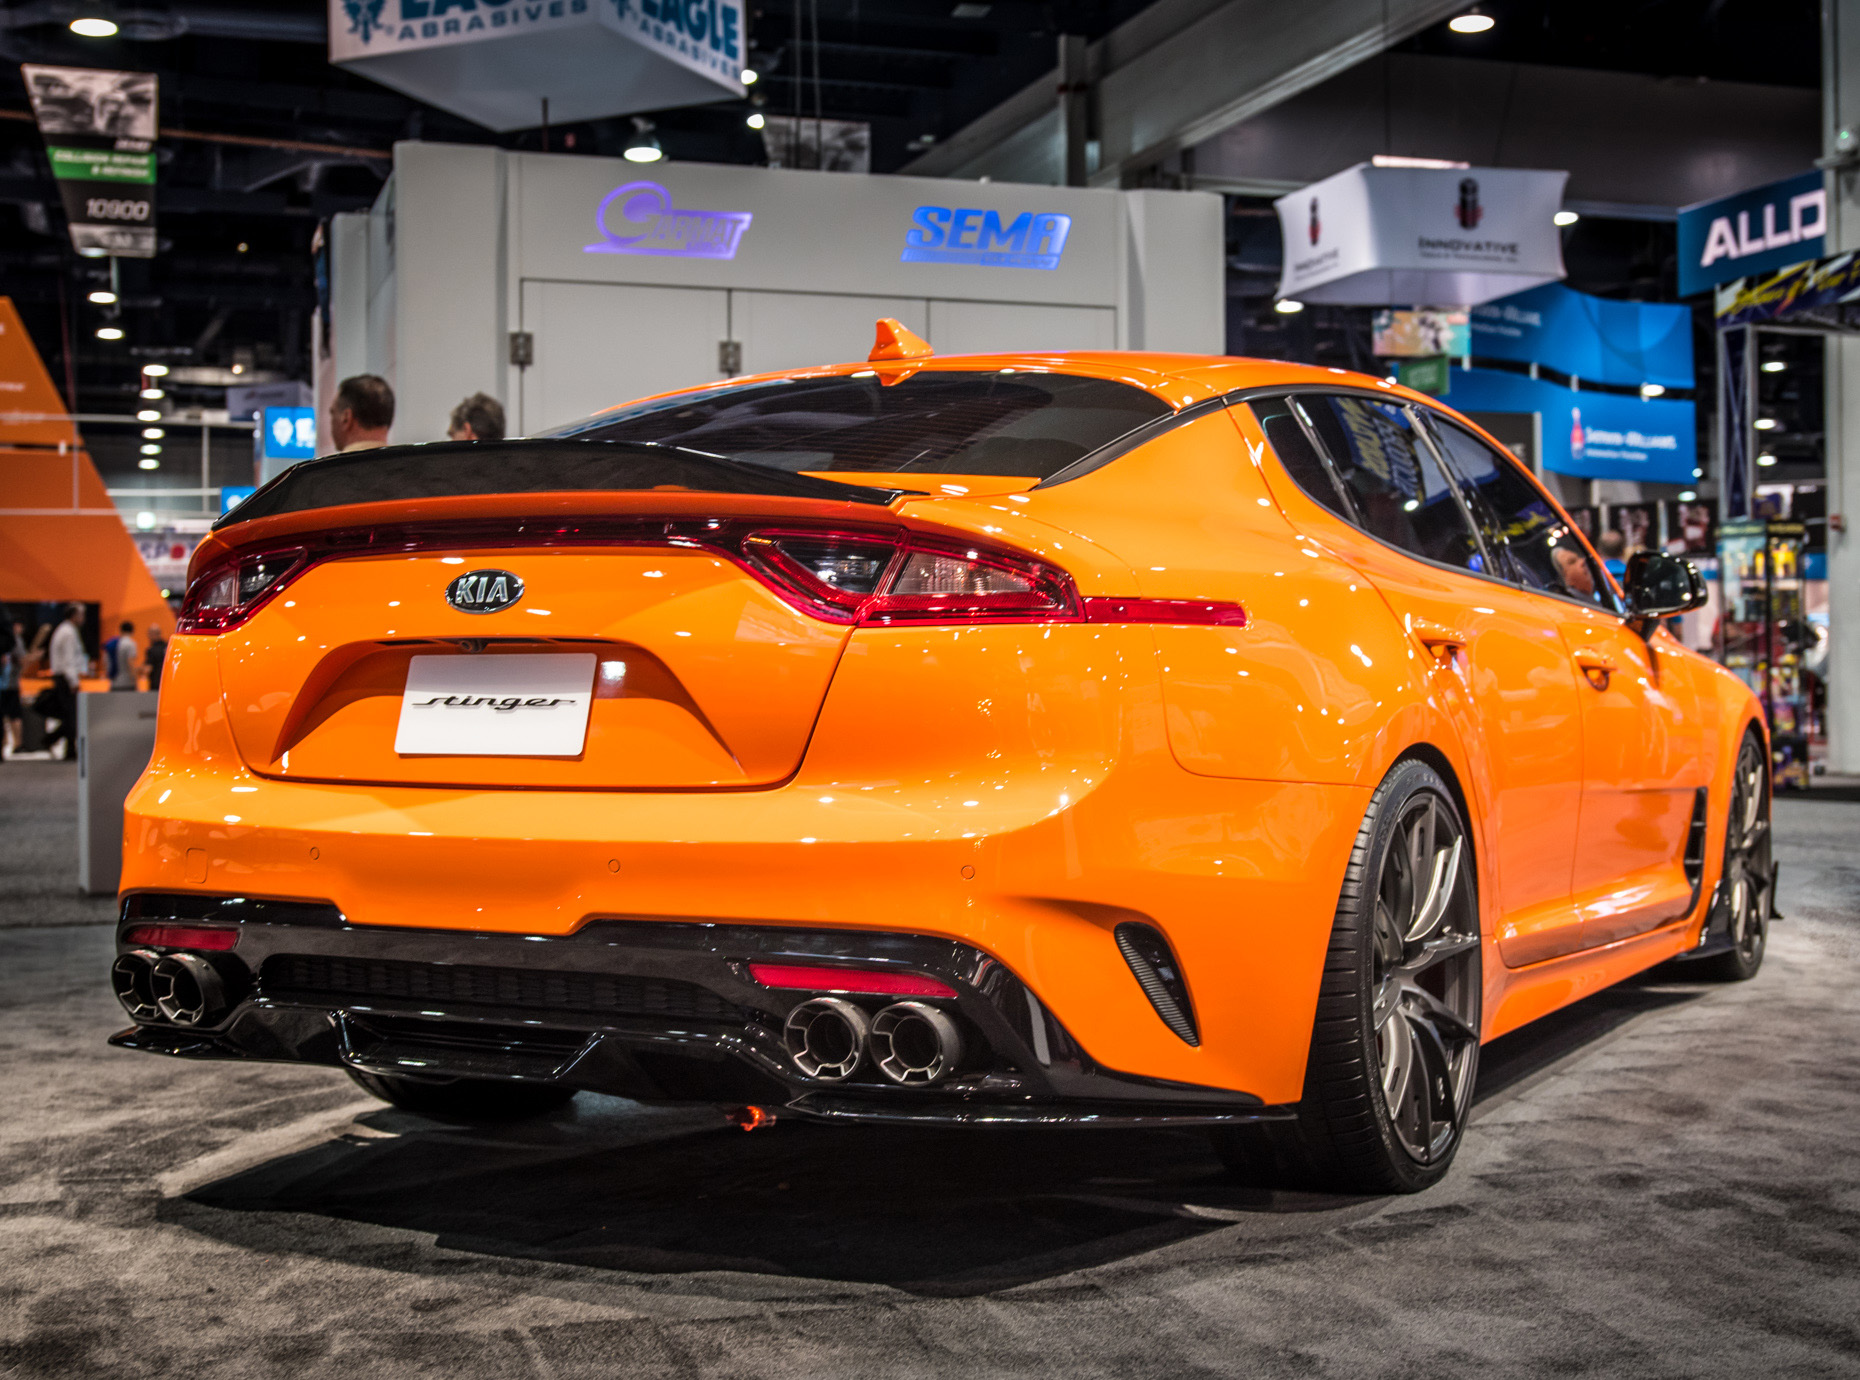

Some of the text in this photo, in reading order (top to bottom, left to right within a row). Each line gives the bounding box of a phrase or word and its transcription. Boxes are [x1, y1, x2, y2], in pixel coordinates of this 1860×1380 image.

[398, 1, 588, 41] ABRASIVES
[905, 206, 1073, 255] SEMA
[1417, 236, 1519, 255] INNOVATIVE
[454, 576, 509, 604] KIA
[411, 695, 576, 711] stinger
